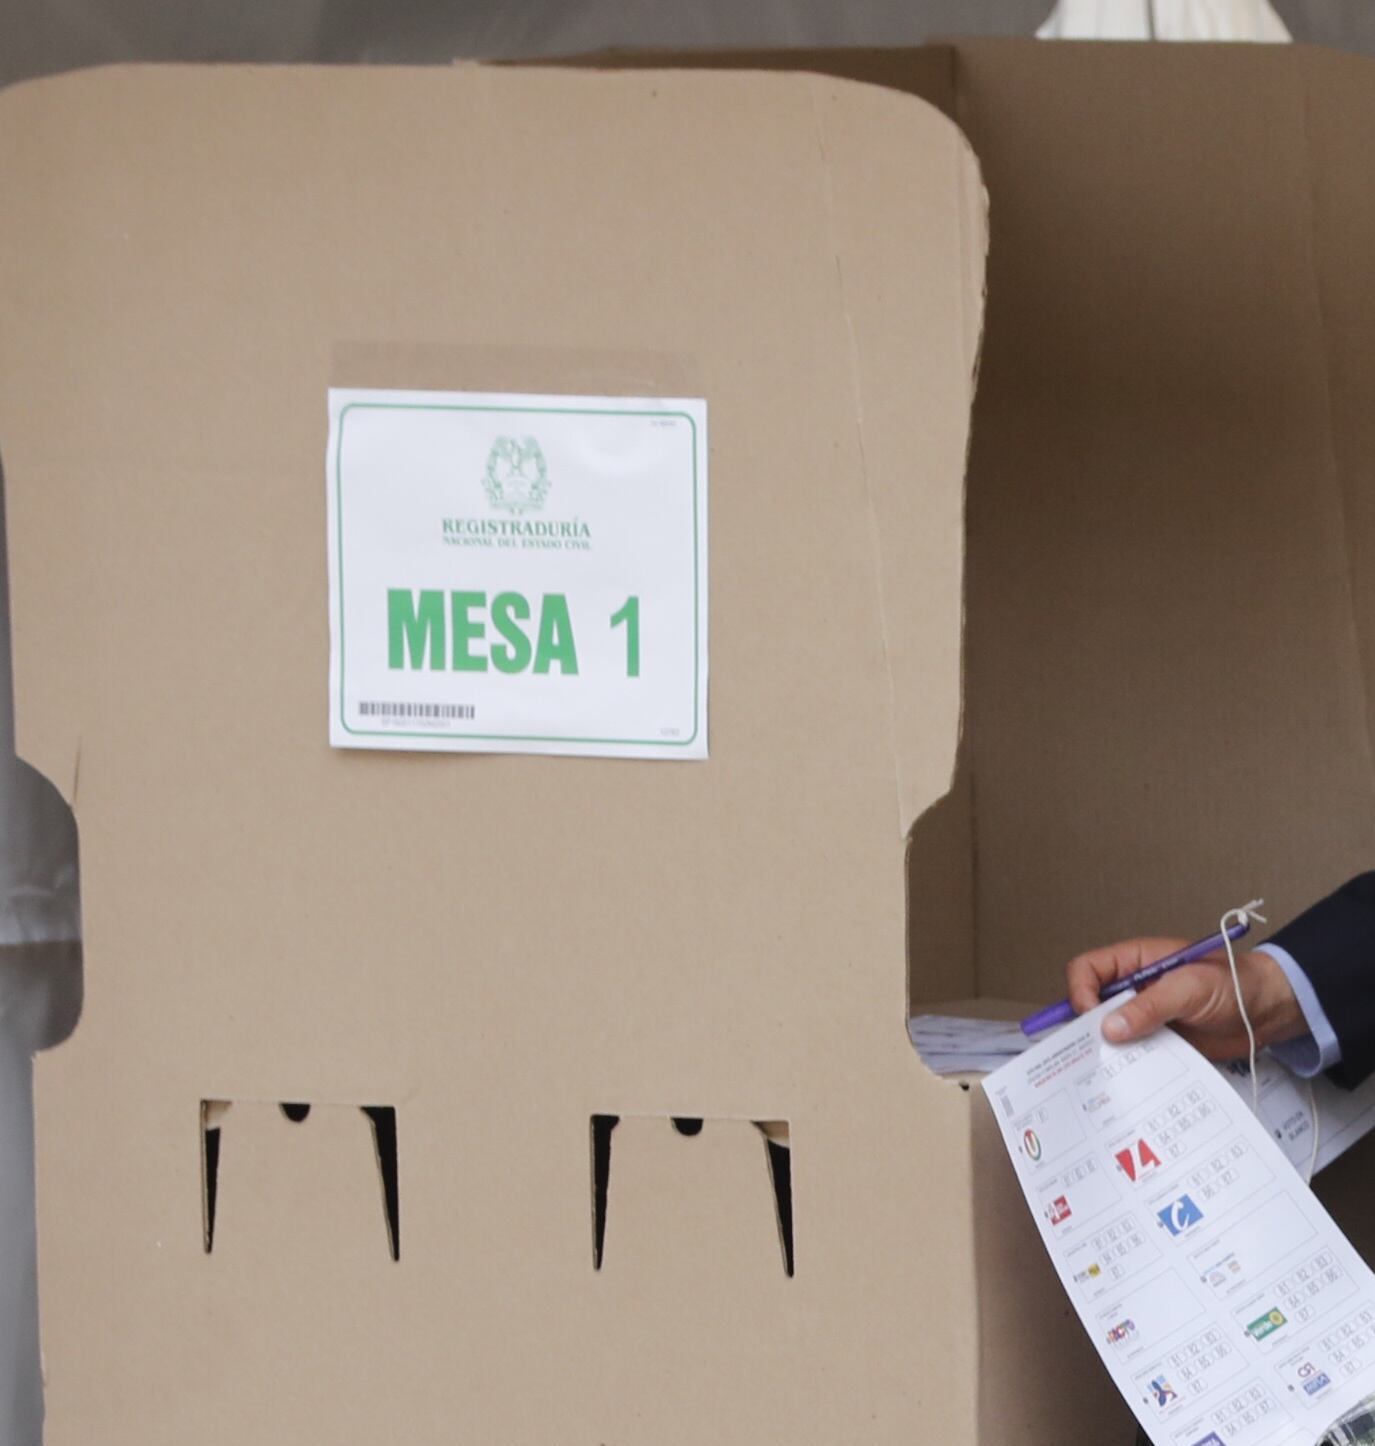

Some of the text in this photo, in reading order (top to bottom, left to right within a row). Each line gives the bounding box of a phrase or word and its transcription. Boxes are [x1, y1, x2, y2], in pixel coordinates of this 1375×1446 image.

[442, 516, 591, 538] REGISTRADURÍA
[387, 587, 640, 677] MESA 1
